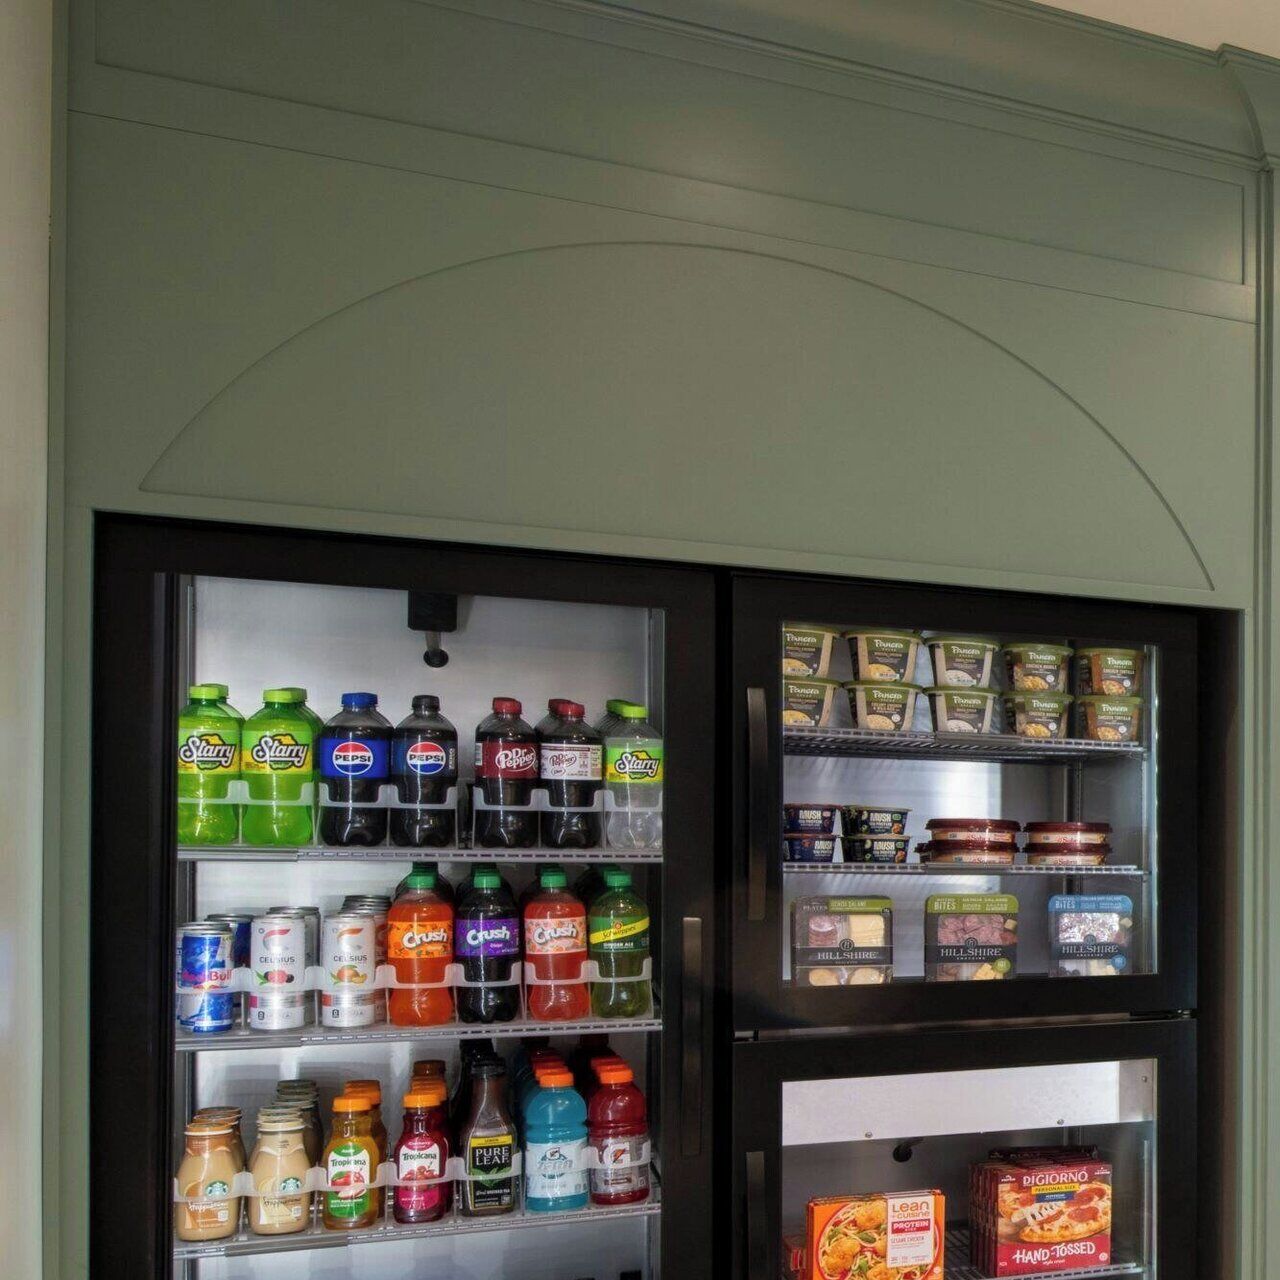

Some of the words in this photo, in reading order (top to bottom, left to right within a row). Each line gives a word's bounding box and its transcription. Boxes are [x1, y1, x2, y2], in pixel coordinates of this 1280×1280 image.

[786, 633, 817, 643] Panera
[874, 639, 904, 649] Panera
[951, 645, 981, 655] Panera
[1028, 652, 1057, 661] Panera
[1106, 657, 1133, 665] Panera
[788, 685, 820, 695] Panera
[872, 690, 903, 699] Panera
[953, 696, 982, 705] Panera
[1032, 699, 1059, 708] Panera
[1101, 703, 1128, 712] Panera
[180, 734, 235, 768] Starry
[252, 734, 308, 768] Starry
[514, 748, 527, 757] Dr
[409, 754, 444, 762] PEPSI
[499, 752, 535, 767] Pepper
[616, 754, 659, 776] Starry
[799, 810, 822, 820] MUSH
[870, 813, 892, 822] MUSH
[874, 841, 895, 850] MUSH
[934, 901, 956, 910] BITES
[1055, 900, 1076, 909] BITES
[402, 929, 448, 949] Crush
[466, 926, 511, 946] Crush
[533, 923, 578, 945] Crush
[940, 947, 1002, 957] HILLSHIRE
[1061, 944, 1119, 954] HILLSHIRE
[817, 951, 878, 960] HILLSHIRE
[402, 1152, 437, 1161] Tropicana
[476, 1147, 510, 1157] PURE
[476, 1156, 509, 1166] LEAF
[892, 1201, 930, 1213] Lean
[893, 1221, 929, 1230] PROTEIN
[1012, 1241, 1096, 1264] HAND-TOSSED
